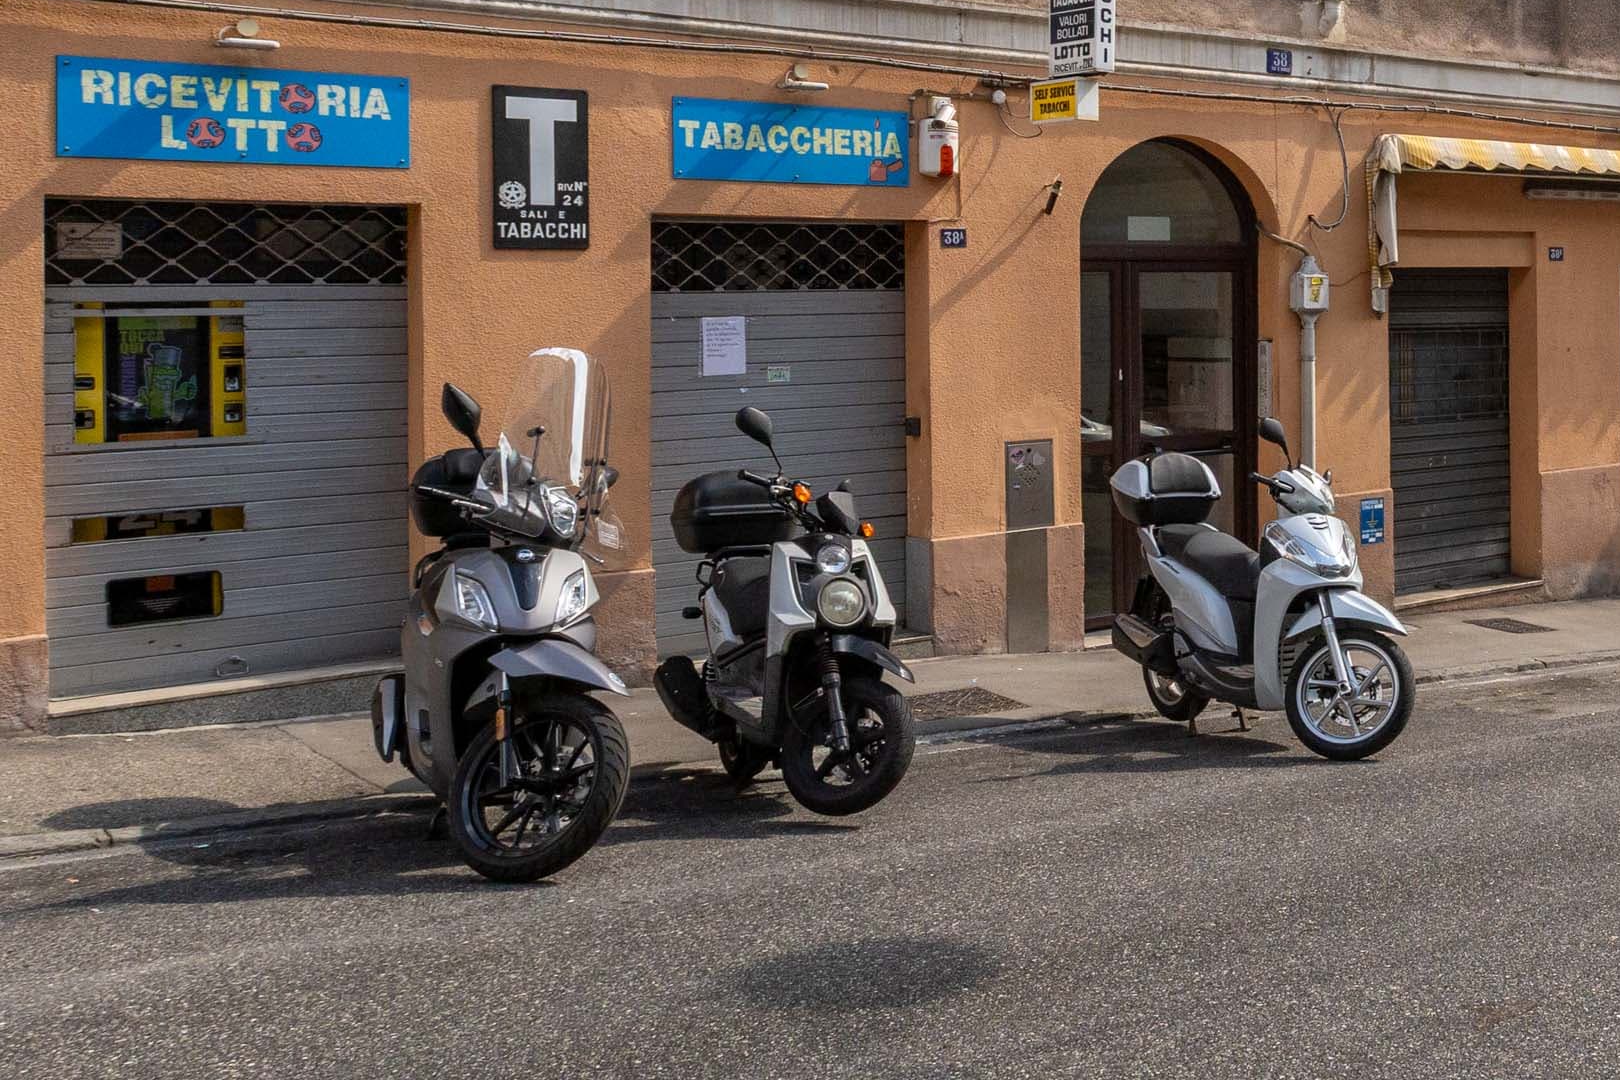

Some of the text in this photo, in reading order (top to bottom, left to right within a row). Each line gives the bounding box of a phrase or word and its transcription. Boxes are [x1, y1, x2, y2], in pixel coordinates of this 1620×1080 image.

[1059, 13, 1087, 26] VALORI
[1056, 25, 1089, 40] BOLLATI
[1054, 42, 1090, 60] LOTTO
[1273, 52, 1288, 67] 38
[80, 69, 391, 120] RICEVITORIA
[1034, 84, 1076, 101] SELF SERVICE
[1039, 100, 1070, 114] TABACCHI
[160, 115, 323, 152] LOTTO
[678, 119, 903, 158] TABACCHERIA
[505, 96, 578, 206] T
[562, 195, 584, 206] 24
[520, 210, 566, 219] SALI E
[497, 222, 587, 239] TABACCHI
